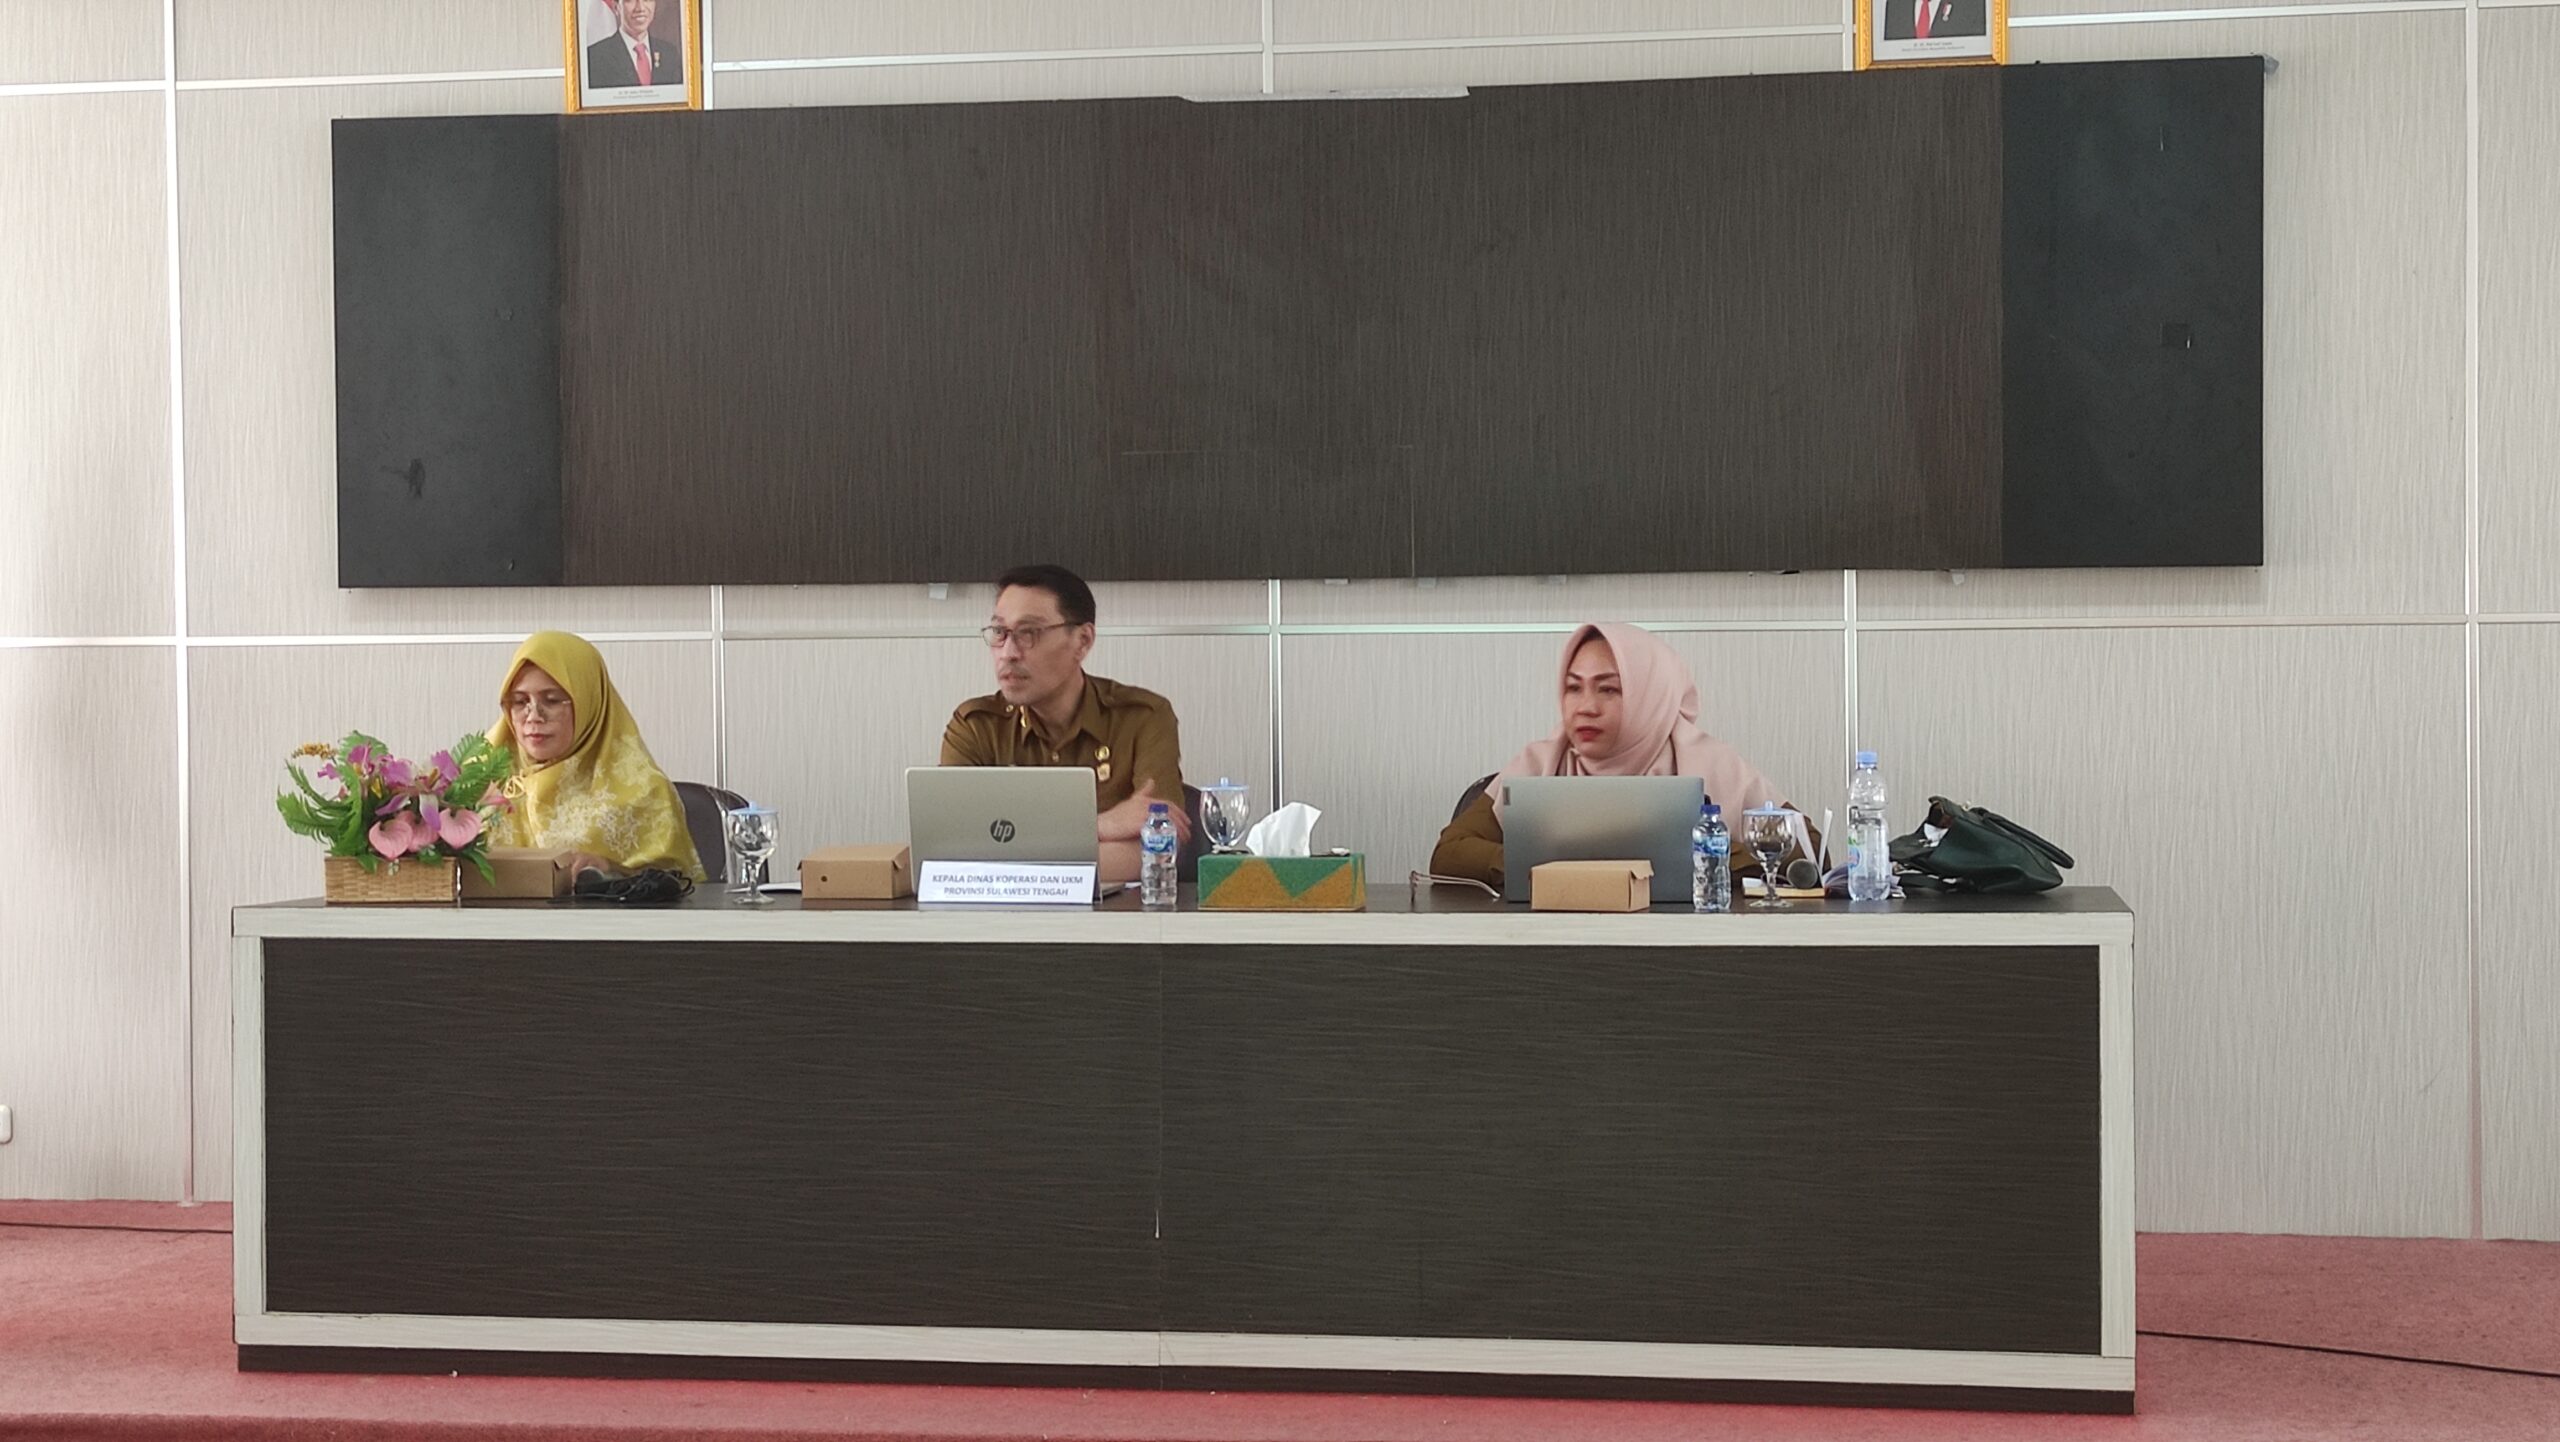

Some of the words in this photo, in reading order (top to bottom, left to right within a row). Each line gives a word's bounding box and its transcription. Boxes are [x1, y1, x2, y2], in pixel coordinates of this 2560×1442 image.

[993, 819, 1012, 843] hp
[932, 874, 965, 883] KEPALA
[967, 874, 994, 884] DINAS
[996, 874, 1038, 884] KOPERASI
[1040, 875, 1060, 884] DAN
[1061, 875, 1084, 884] UKM
[943, 887, 985, 895] PROVINSI
[1032, 887, 1069, 896] TENGAH
